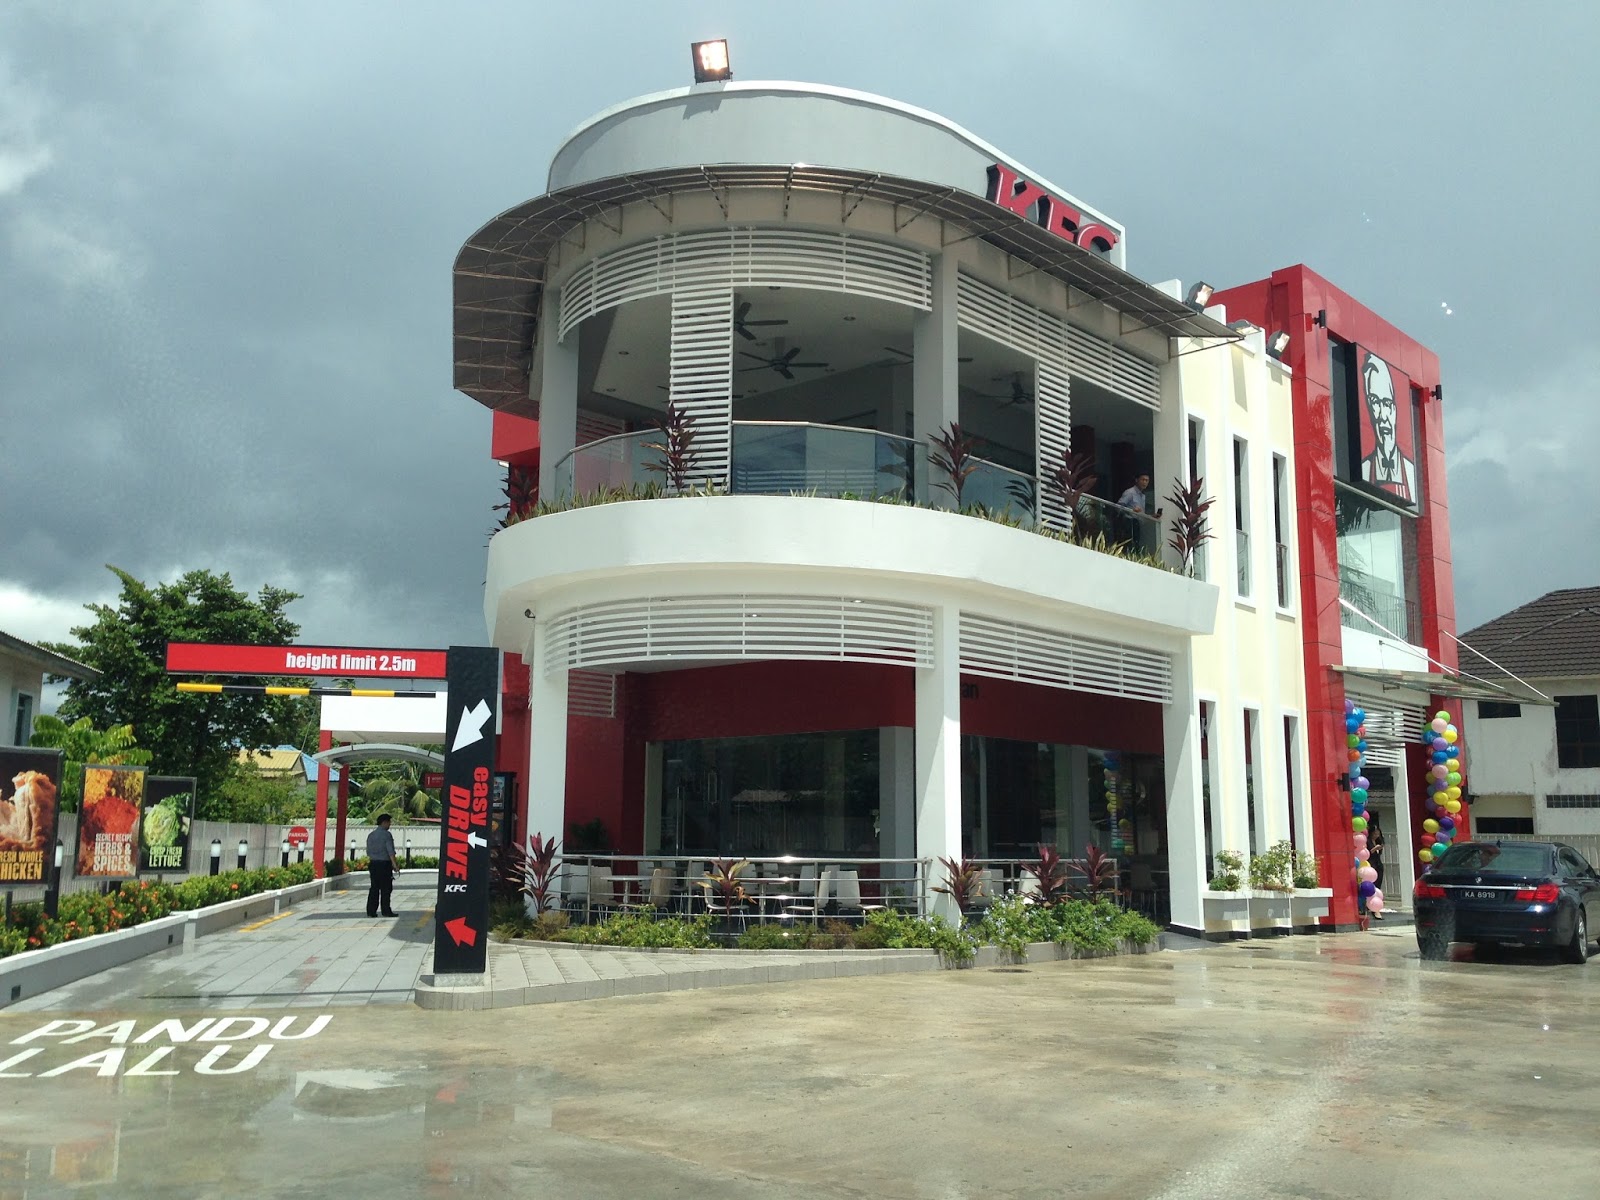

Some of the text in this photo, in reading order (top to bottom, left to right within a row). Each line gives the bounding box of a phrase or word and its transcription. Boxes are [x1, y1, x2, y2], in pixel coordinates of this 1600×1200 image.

[987, 163, 1118, 252] KFC
[286, 652, 416, 672] height limit 2.5m
[470, 767, 489, 826] easy
[95, 833, 132, 842] SECRET RECIPE
[446, 784, 471, 881] DRIVE
[0, 850, 44, 862] RESH WHOLE
[94, 841, 132, 855] HERBS &
[166, 846, 183, 855] FRESH
[93, 855, 131, 872] SPICES
[148, 854, 182, 867] LETTUCE
[0, 862, 43, 880] HICKEN
[444, 884, 467, 893] KFC
[8, 1014, 334, 1045] PANDU
[0, 1044, 275, 1078] LALU
